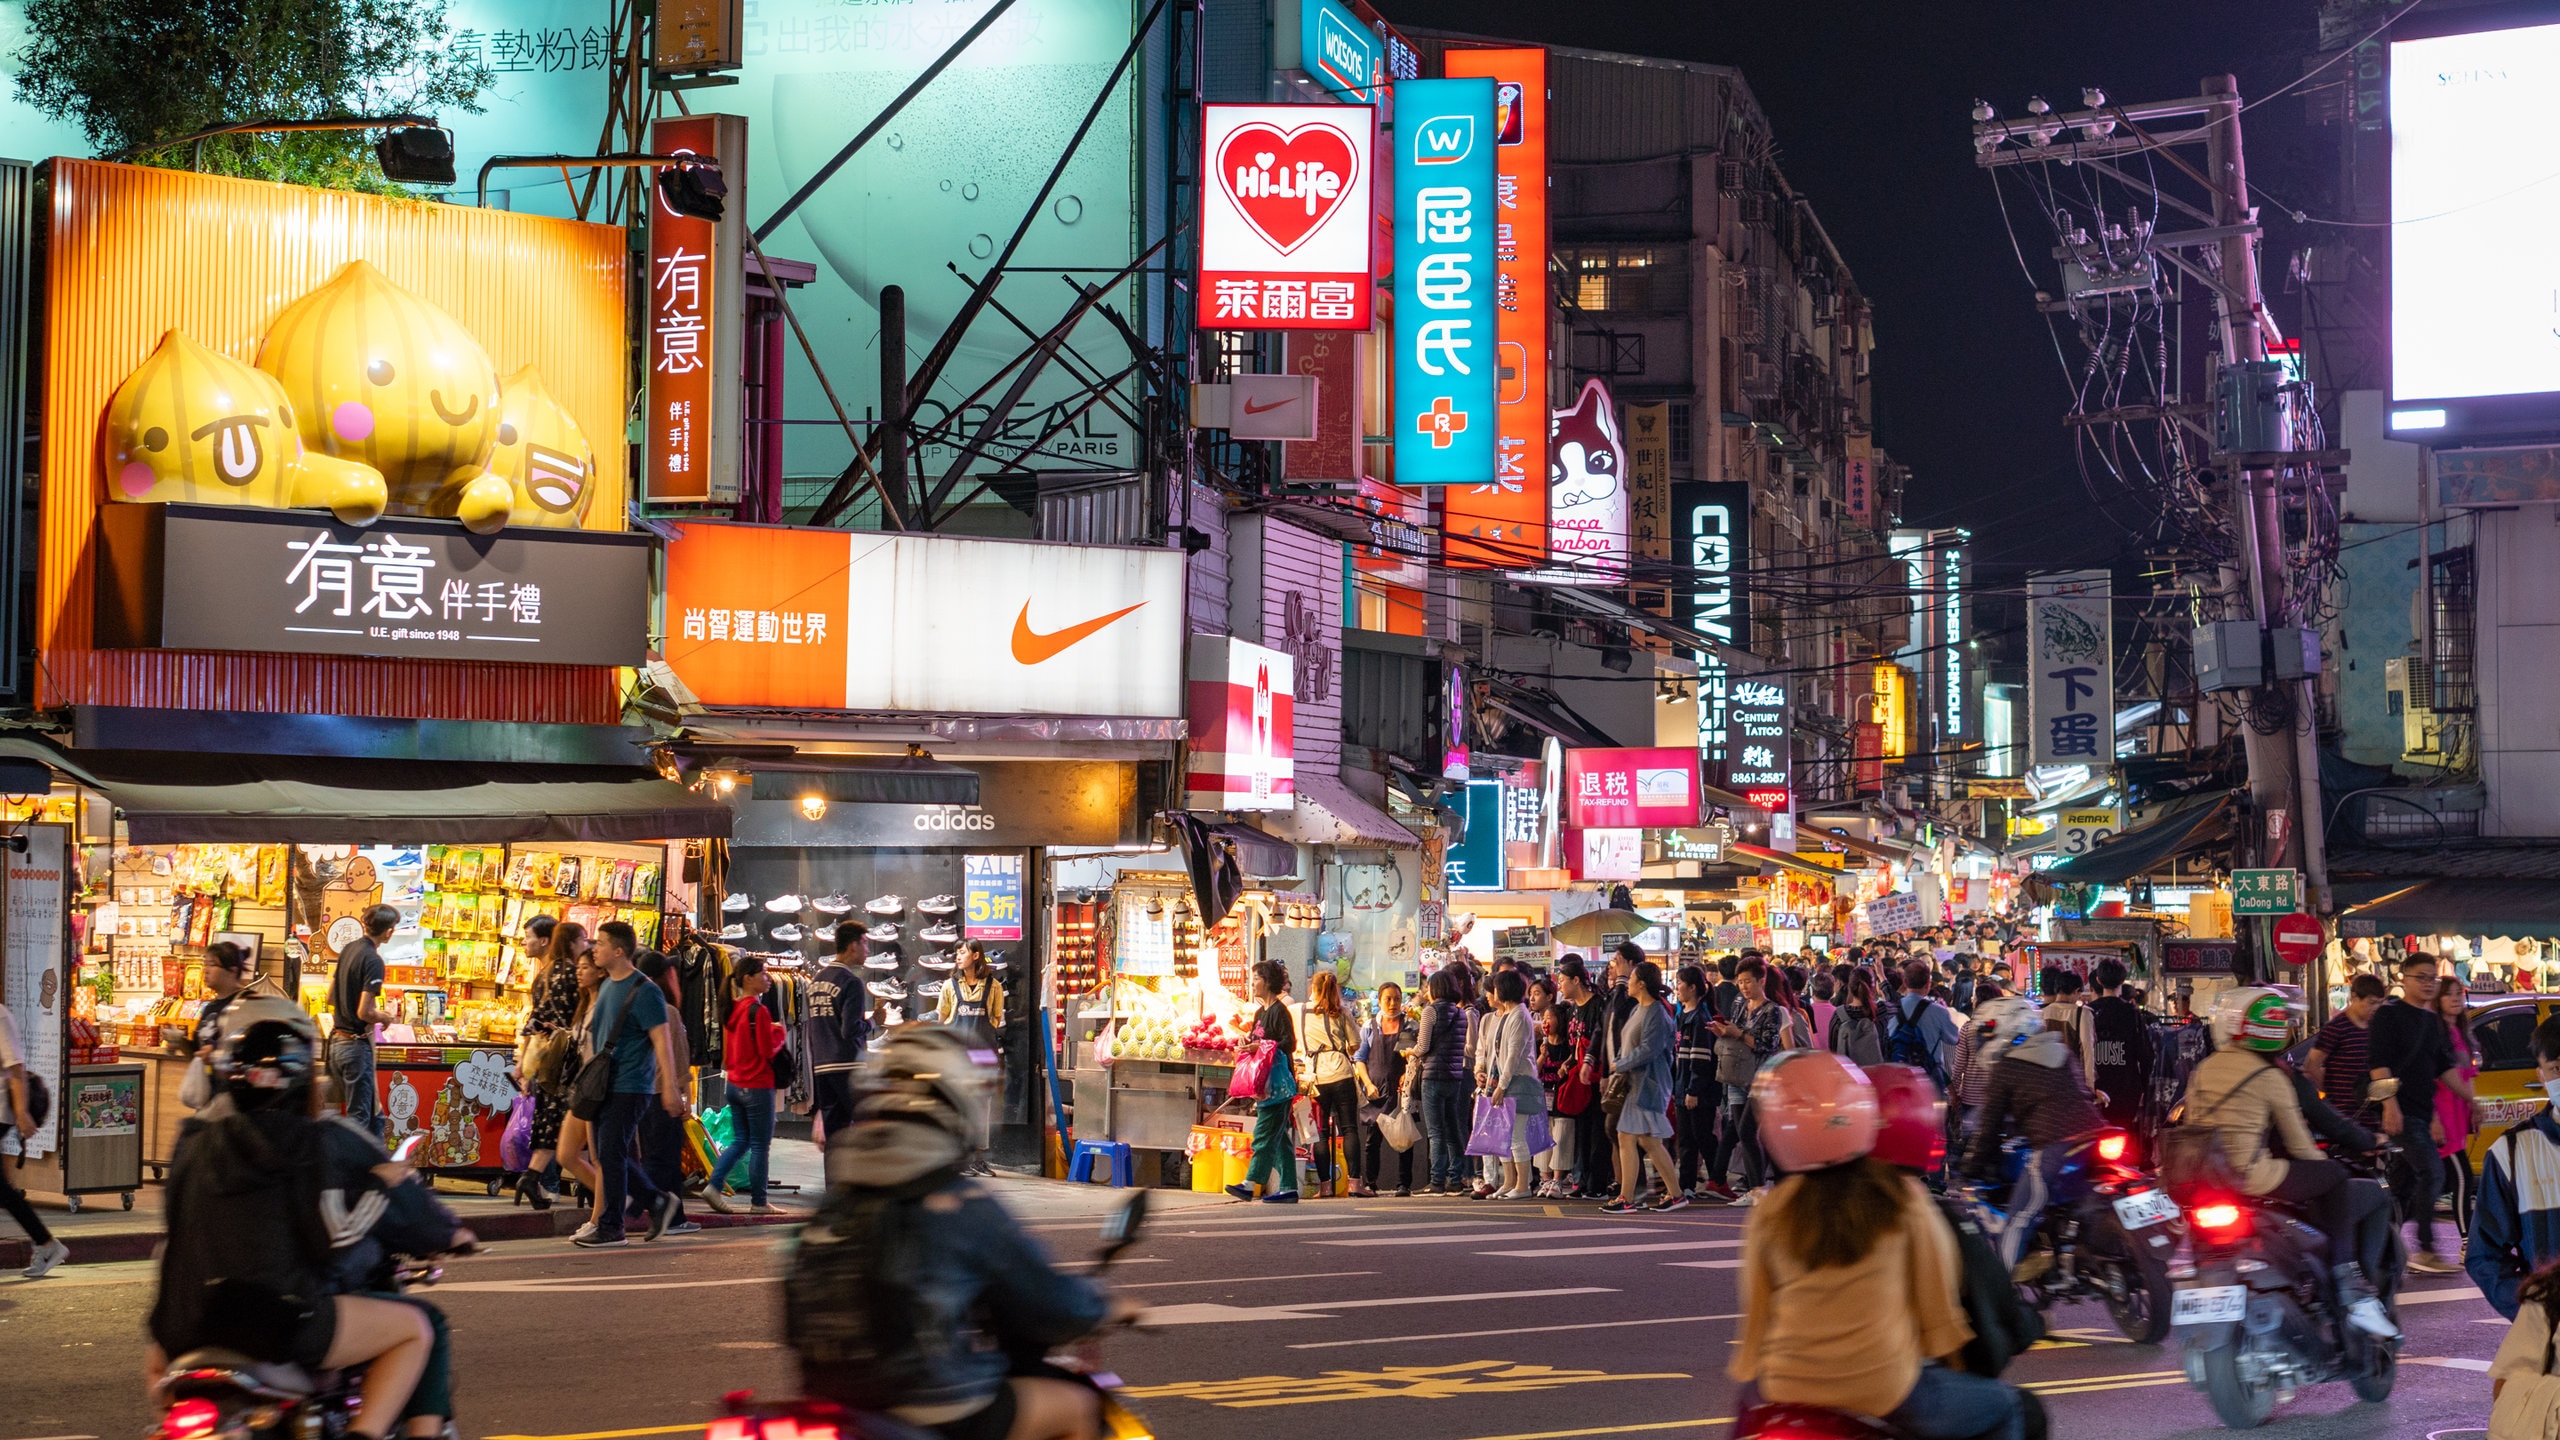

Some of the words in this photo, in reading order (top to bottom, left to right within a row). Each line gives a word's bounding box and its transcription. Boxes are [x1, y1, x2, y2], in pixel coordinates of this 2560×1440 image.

[1324, 26, 1363, 82] watsons
[1416, 187, 1472, 375] 屈臣氏
[656, 247, 706, 374] 有意
[1215, 279, 1355, 320] 萊爾富
[668, 401, 682, 473] 伴手禮
[1057, 442, 1118, 456] PARIS
[1552, 518, 1604, 530] ecca
[1552, 529, 1611, 551] onbon
[286, 531, 436, 620] 有意
[440, 578, 541, 624] 伴手禮
[1947, 576, 1960, 644] UNDER
[370, 627, 390, 638] U.E.
[391, 627, 408, 641] gift
[409, 629, 435, 641] since
[436, 630, 460, 641] 1948
[683, 608, 827, 646] 尚智運動世界
[1947, 648, 1960, 734] ARMOUR
[1733, 710, 1779, 722] CENTURY
[2048, 666, 2098, 757] 下蛋
[1744, 723, 1783, 736] TATTOO
[1579, 798, 1629, 807] TAX-REFUND
[1749, 793, 1785, 802] TATTOO
[914, 801, 996, 832] adidas
[2068, 815, 2109, 823] REMAX
[1683, 843, 1718, 853] YAGER
[2238, 874, 2289, 891] 大東路
[2239, 897, 2272, 909] DaDong
[1421, 904, 1439, 940] 浴巾
[2504, 1101, 2536, 1119] APP
